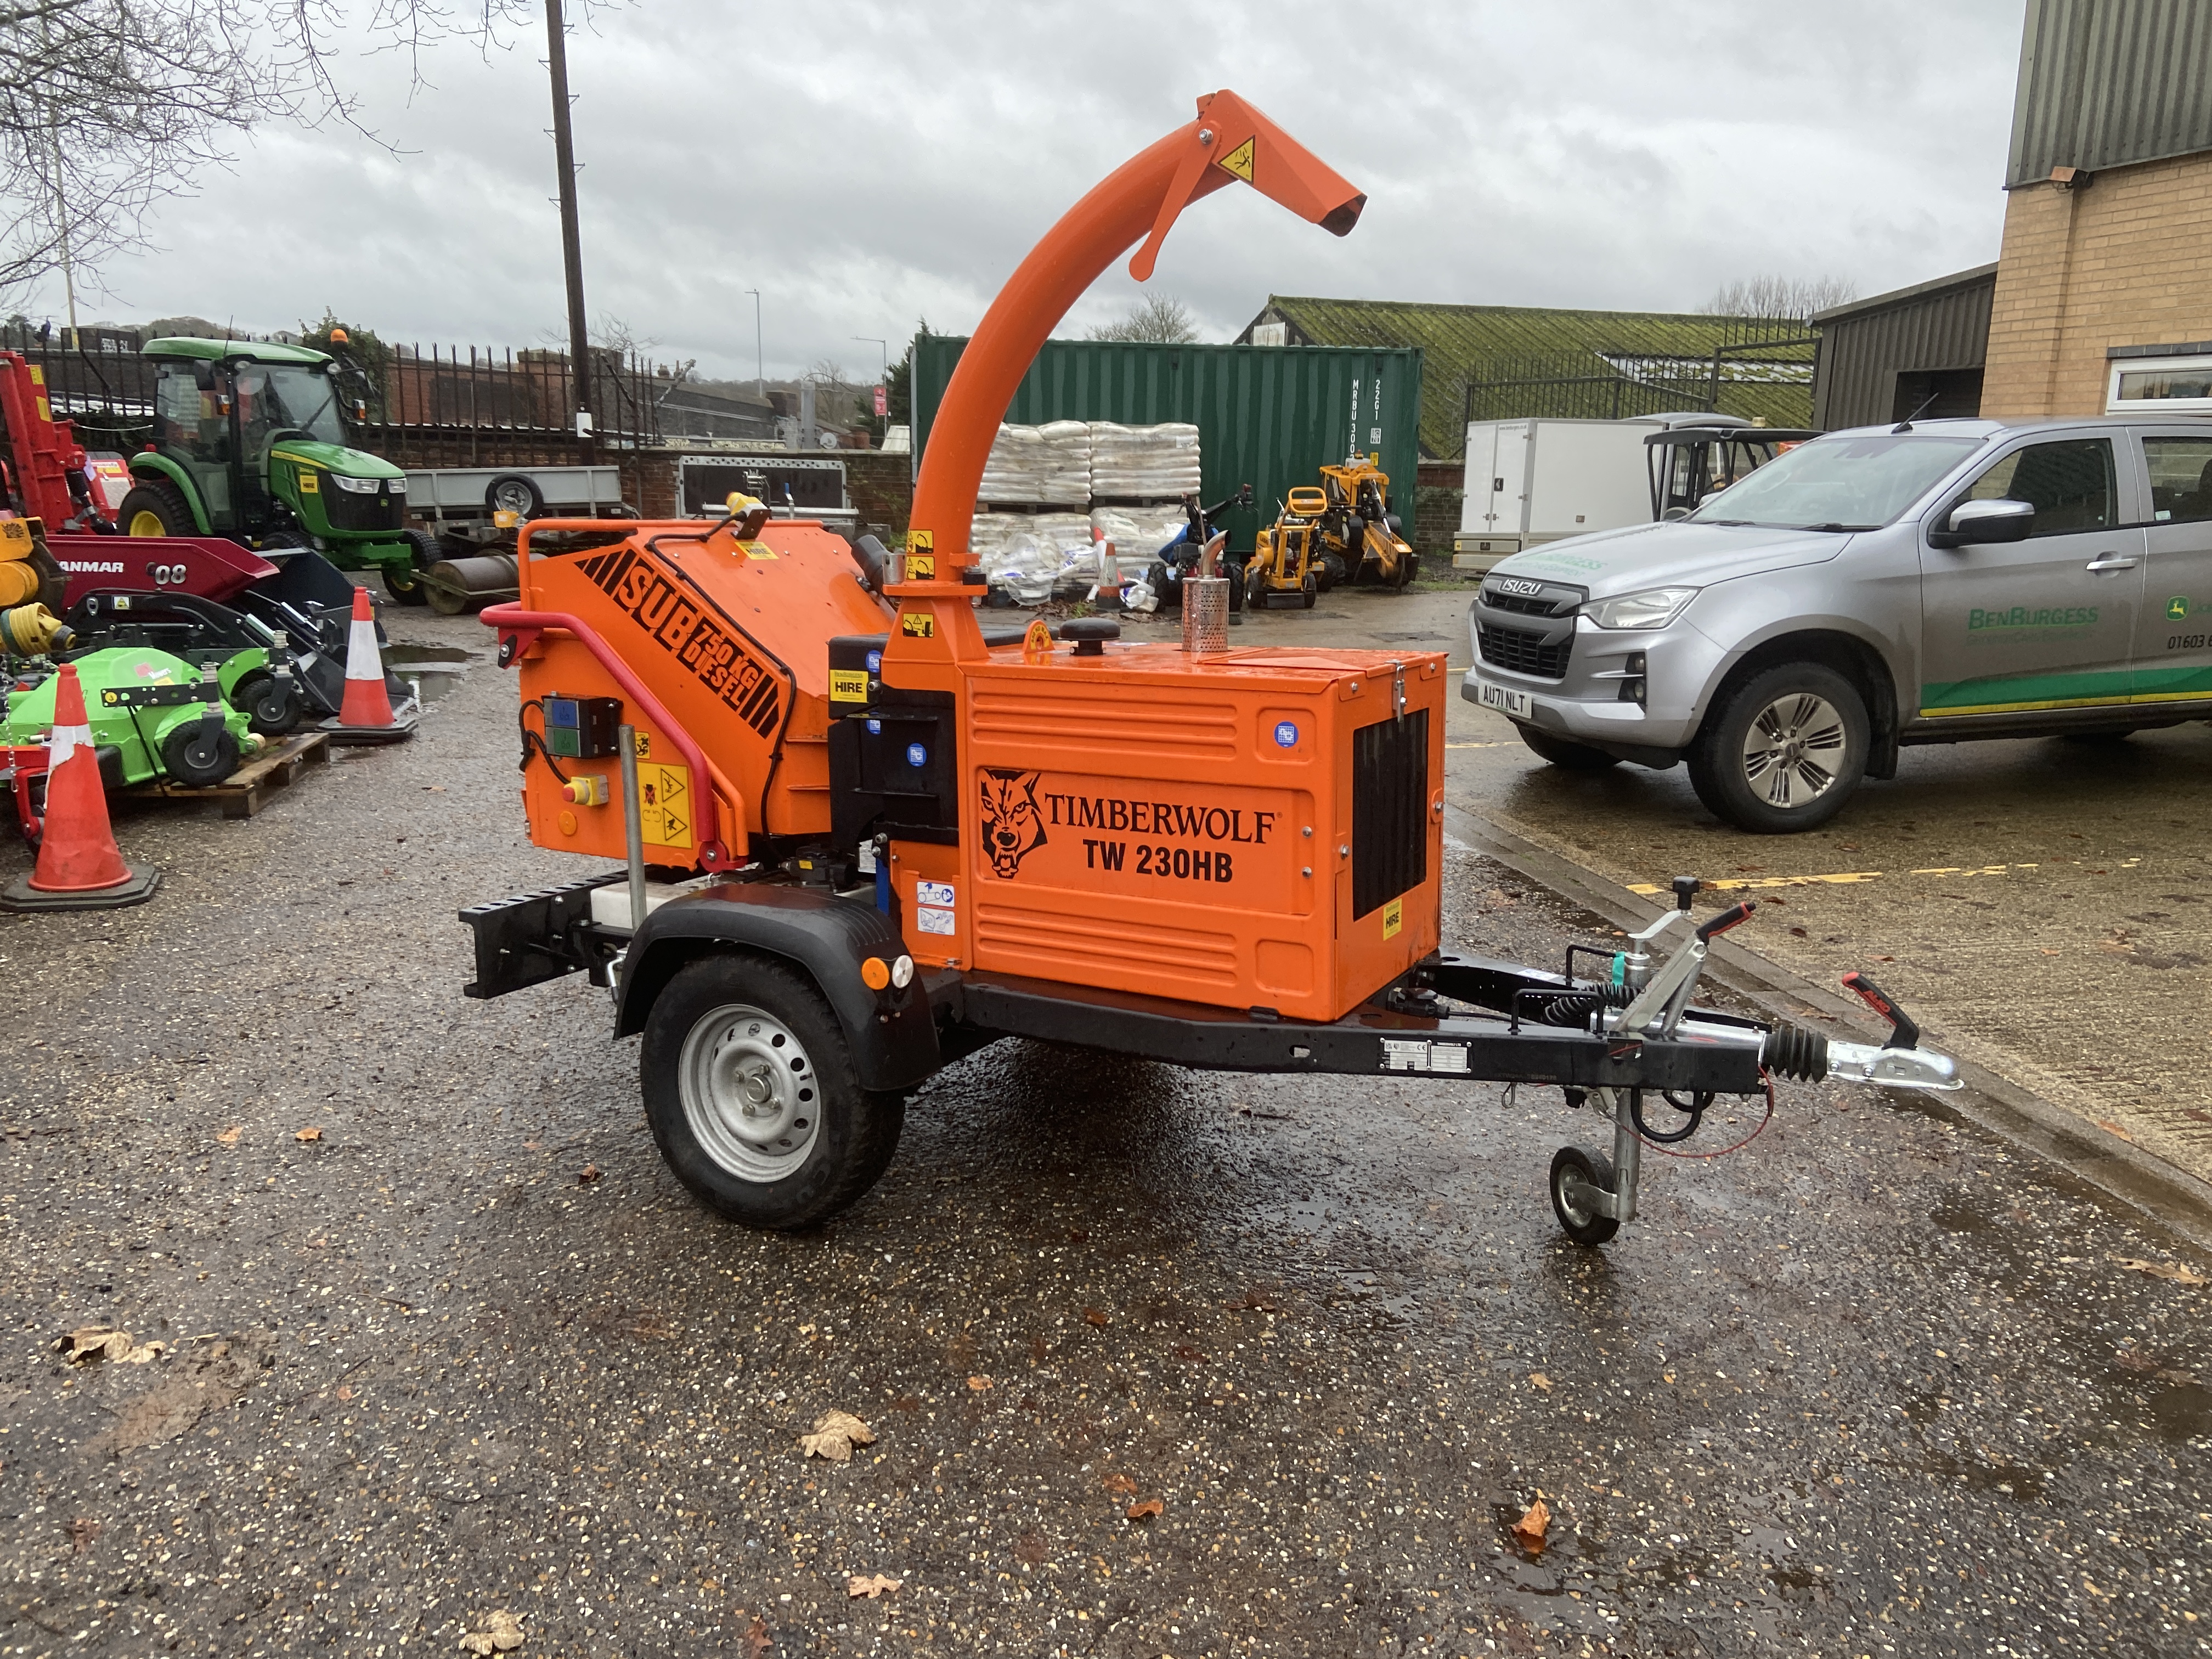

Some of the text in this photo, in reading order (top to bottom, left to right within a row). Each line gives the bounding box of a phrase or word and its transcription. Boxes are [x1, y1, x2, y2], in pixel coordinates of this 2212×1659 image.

[57, 561, 124, 573] ANMAR
[1501, 579, 1541, 595] ISUZU
[617, 563, 699, 651] SUB
[1968, 606, 2100, 630] BENBURGESS
[2168, 635, 2205, 649] 01603
[694, 623, 759, 690] 750 KG
[682, 640, 746, 707] DIESEL
[835, 681, 863, 693] HIRE
[1483, 685, 1525, 713] AU71 NLT
[1045, 792, 1276, 844] TIMBERWOLF
[1082, 839, 1233, 883] TW 230HB
[1386, 911, 1400, 929] HIRE
